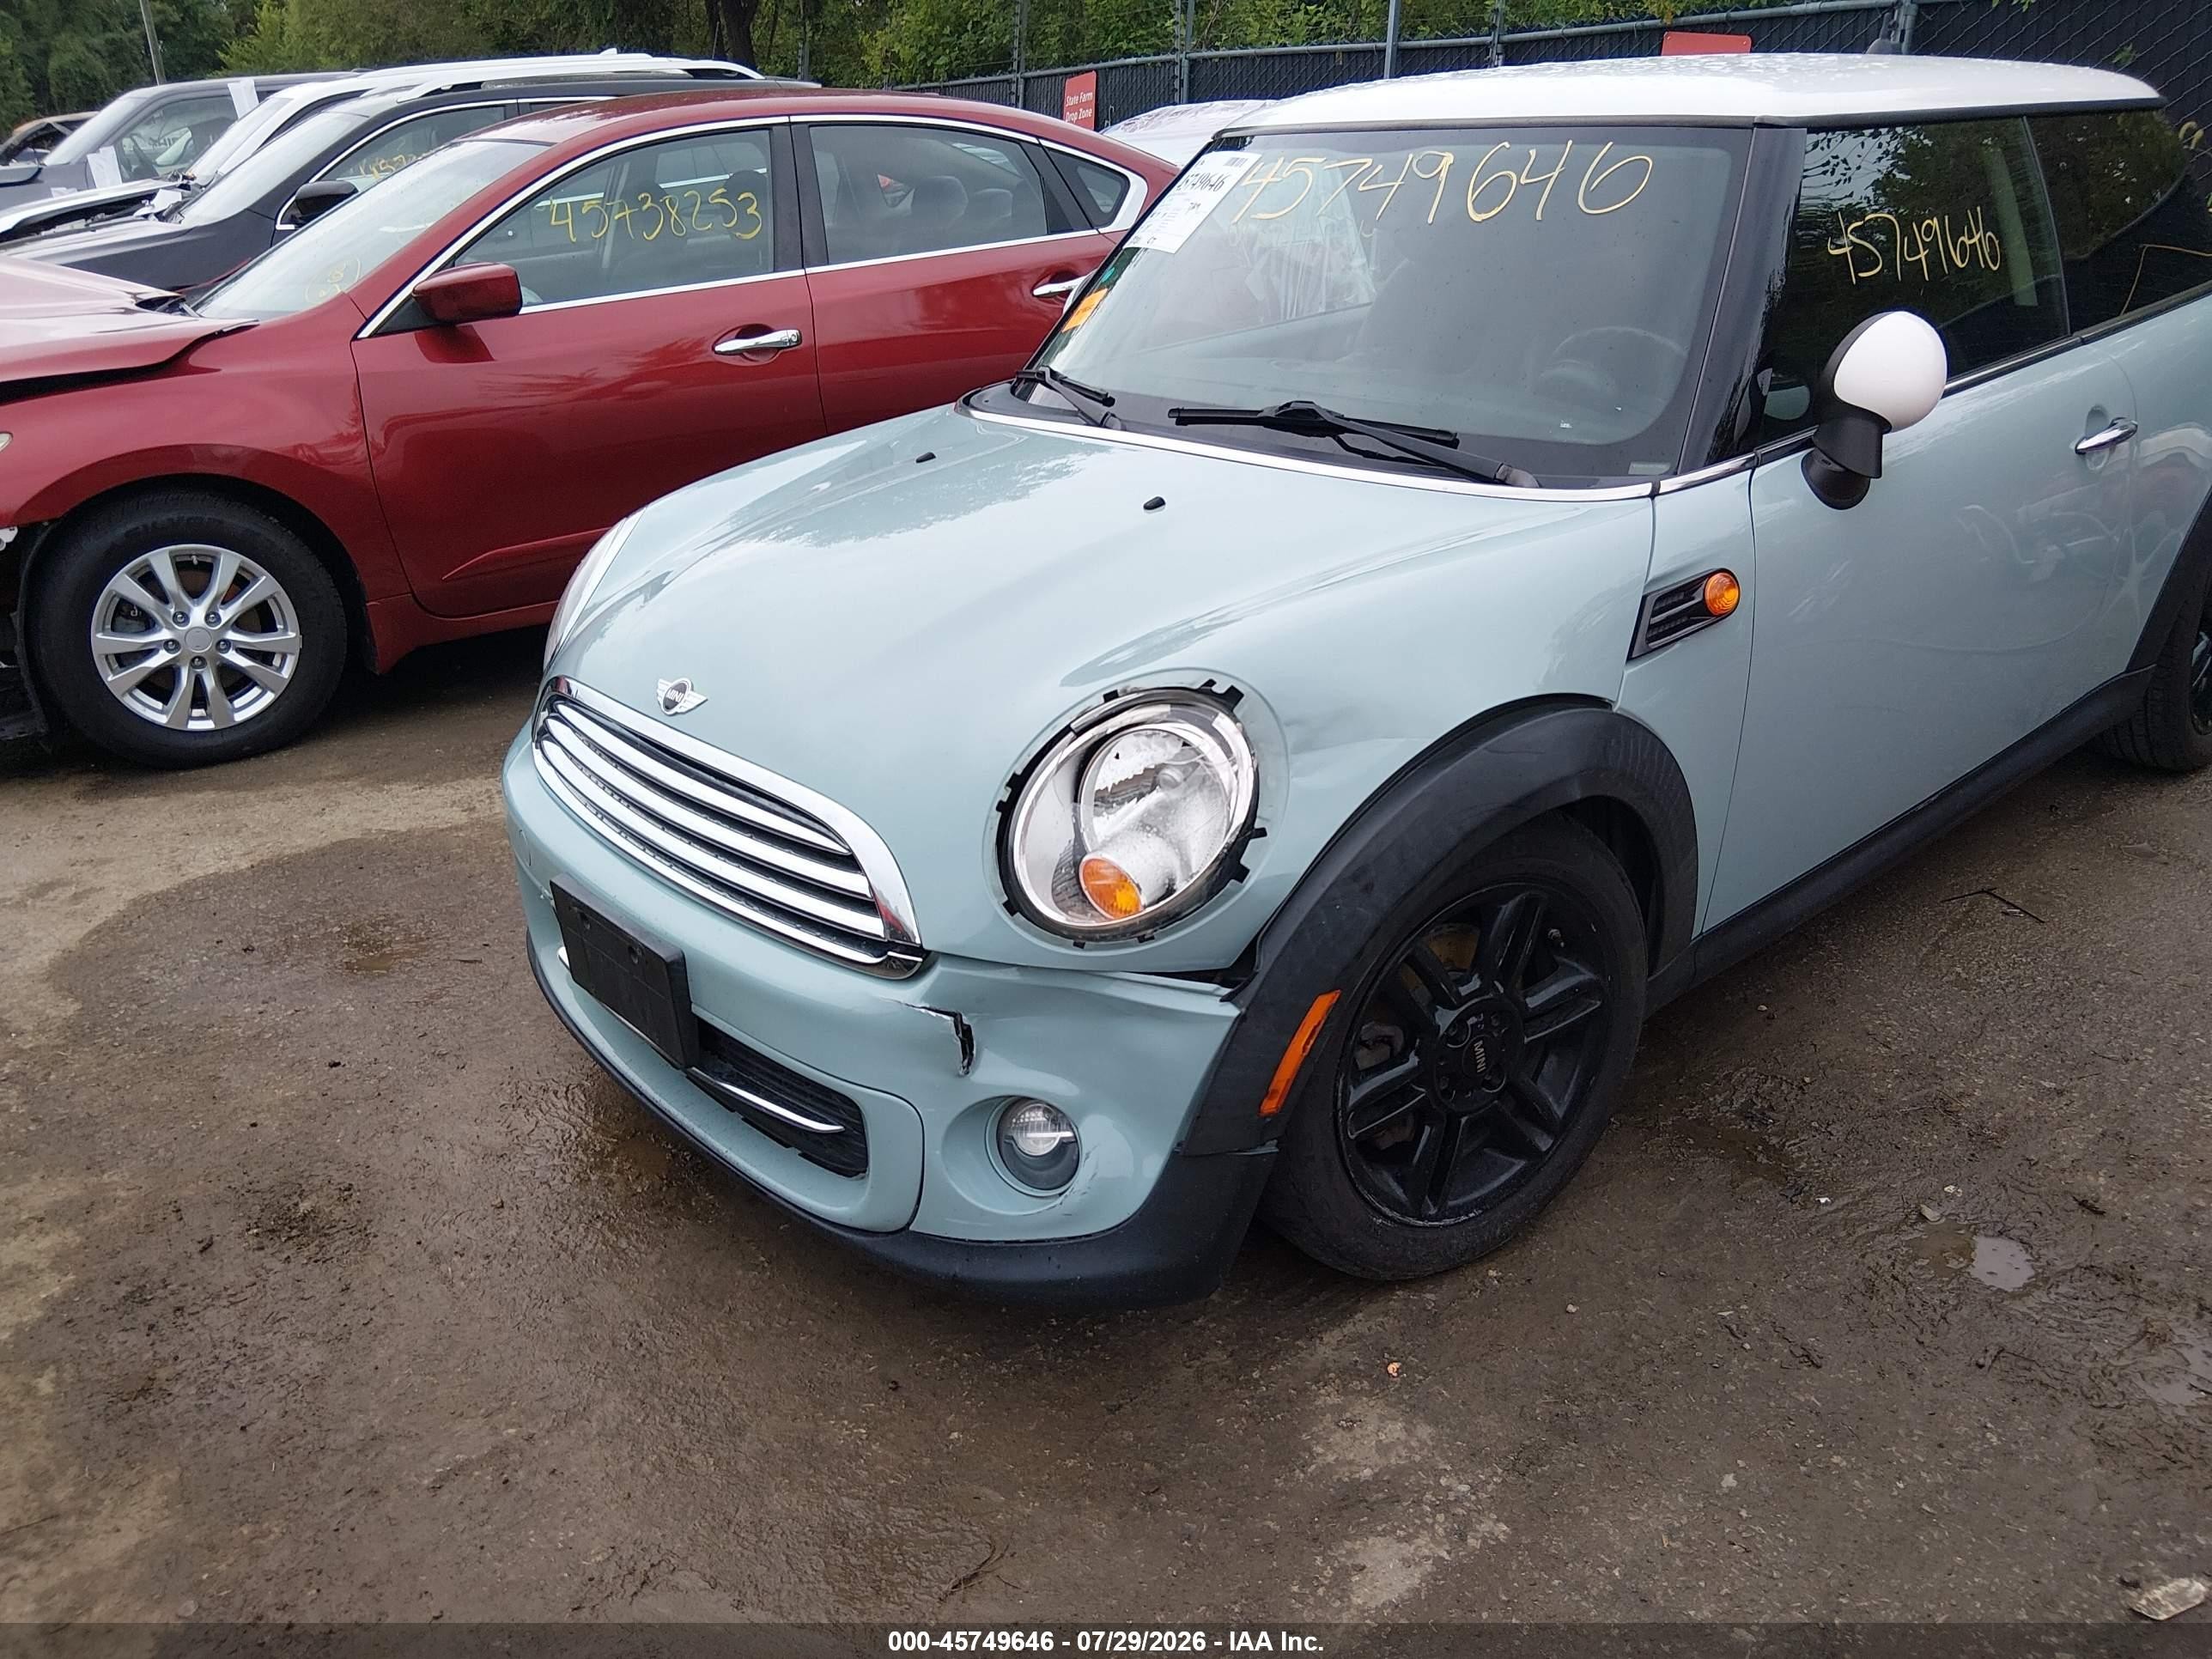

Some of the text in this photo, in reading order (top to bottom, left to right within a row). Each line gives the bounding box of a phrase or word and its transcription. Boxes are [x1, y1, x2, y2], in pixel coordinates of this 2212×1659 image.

[1066, 92, 1093, 107] State Farm
[1066, 108, 1092, 124] Drop Zone
[1231, 140, 1654, 225] 45749646
[550, 187, 763, 243] 45738253
[1827, 205, 2001, 285] 45749646
[666, 688, 686, 703] MINI
[1474, 1040, 1486, 1073] MINI
